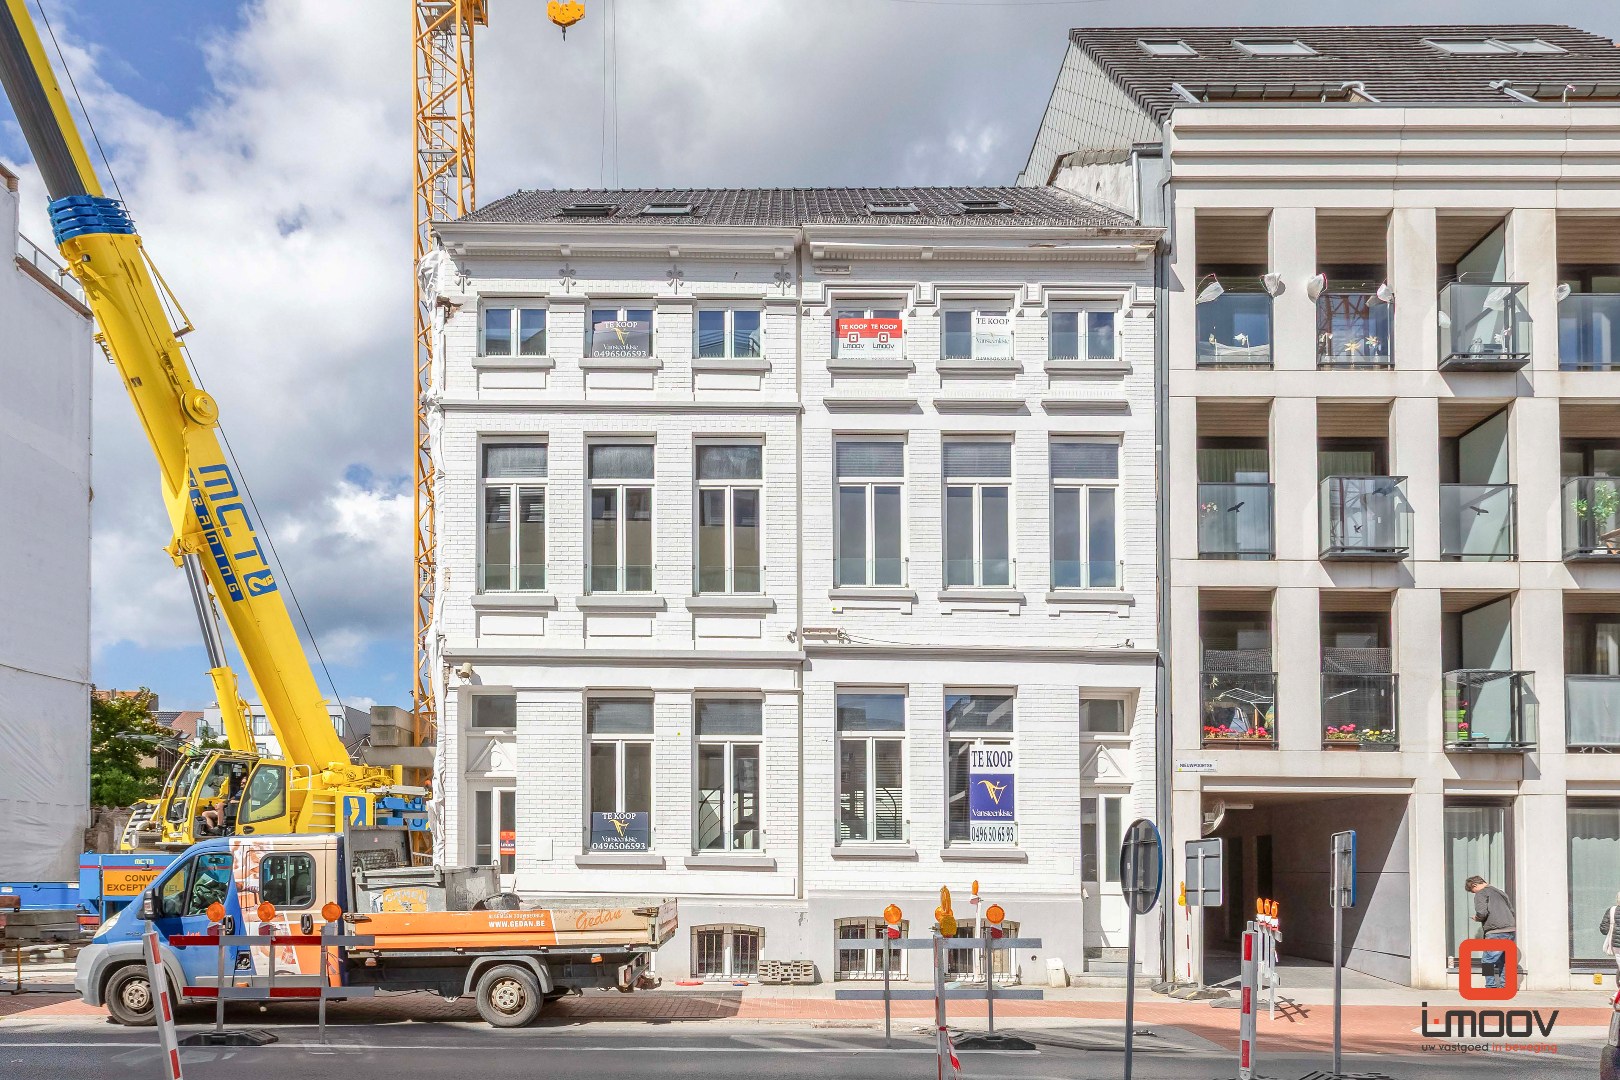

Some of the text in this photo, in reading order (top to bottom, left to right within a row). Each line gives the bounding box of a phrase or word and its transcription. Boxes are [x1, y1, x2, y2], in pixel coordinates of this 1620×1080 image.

[593, 350, 647, 358] 0496506593
[972, 750, 1013, 768] TE KOOP
[602, 812, 637, 820] TE KOOP
[971, 826, 1014, 842] 0496 50 65 93
[592, 842, 646, 850] 0496506593
[488, 920, 545, 928] WWW.GEDAN.BE
[575, 909, 622, 934] Gedan
